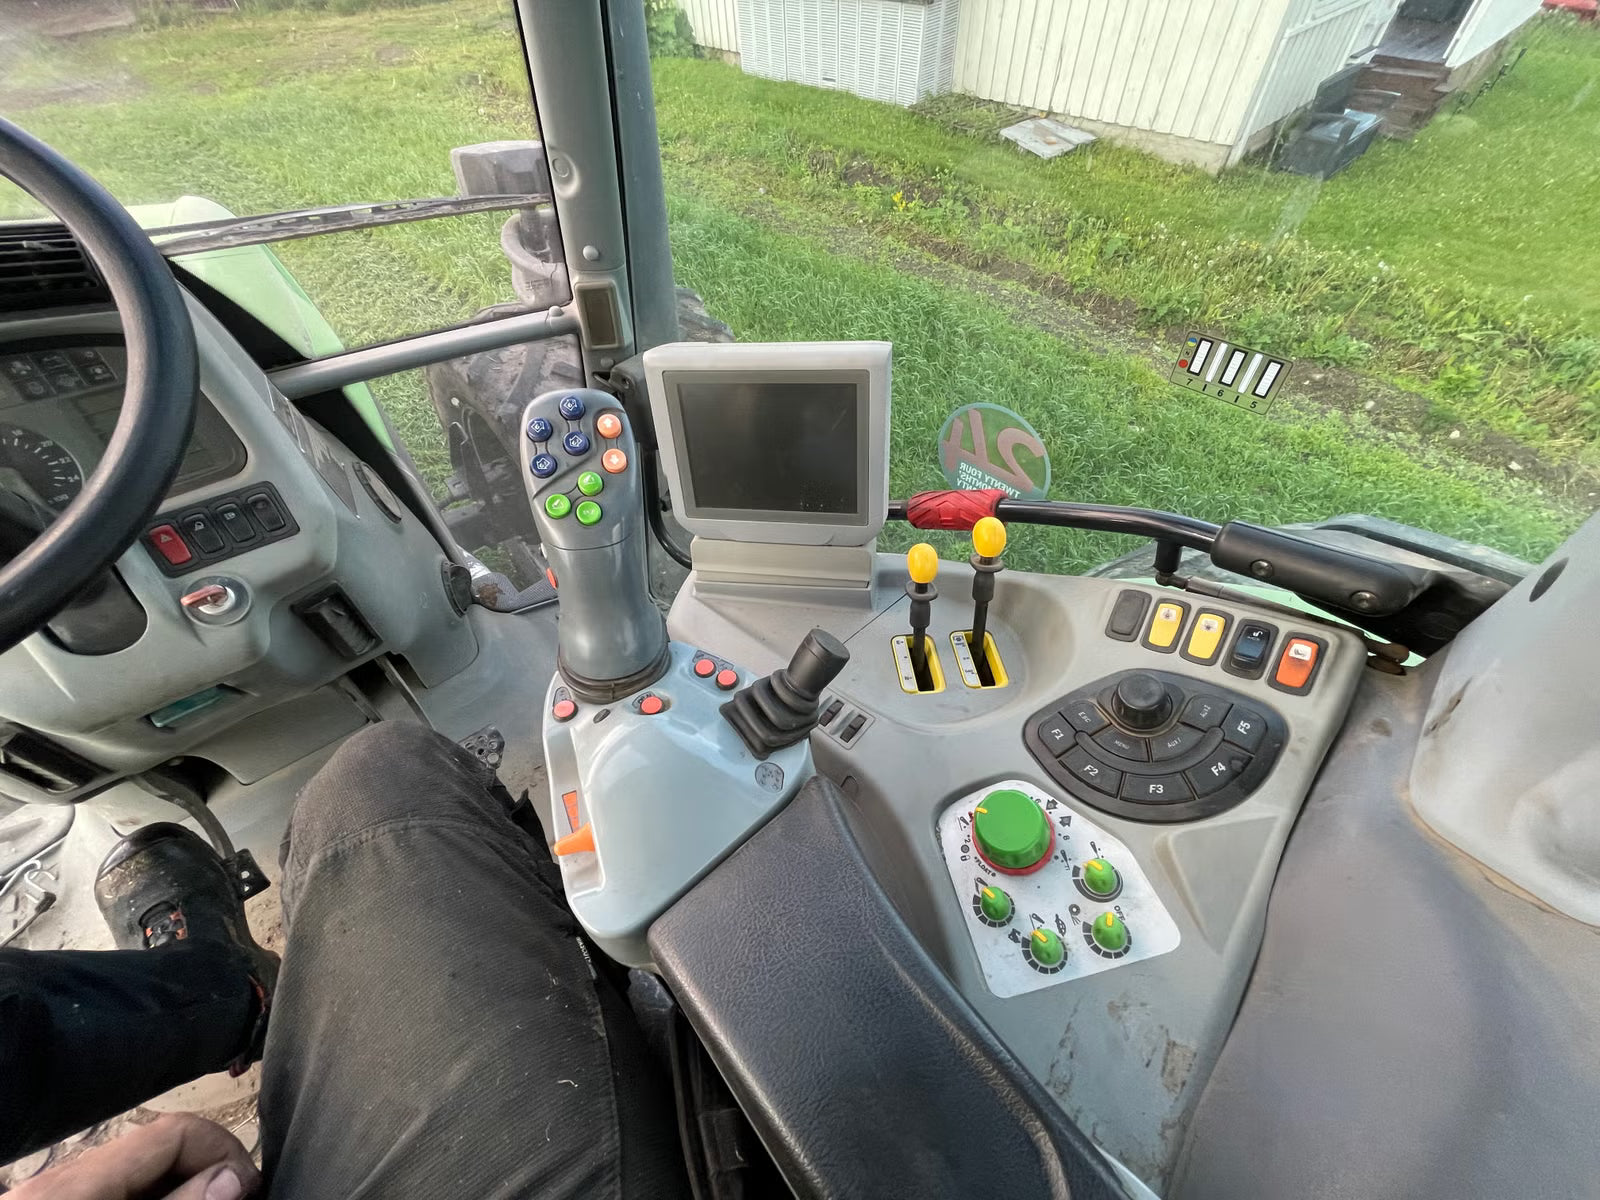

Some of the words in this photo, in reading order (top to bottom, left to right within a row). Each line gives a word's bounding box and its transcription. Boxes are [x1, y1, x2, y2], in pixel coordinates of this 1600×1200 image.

[1051, 728, 1065, 740] F1
[1237, 720, 1251, 735] F5
[1083, 764, 1099, 776] F2
[1210, 762, 1227, 777] F4
[1149, 784, 1164, 794] F3
[976, 860, 992, 875] FLOAT
